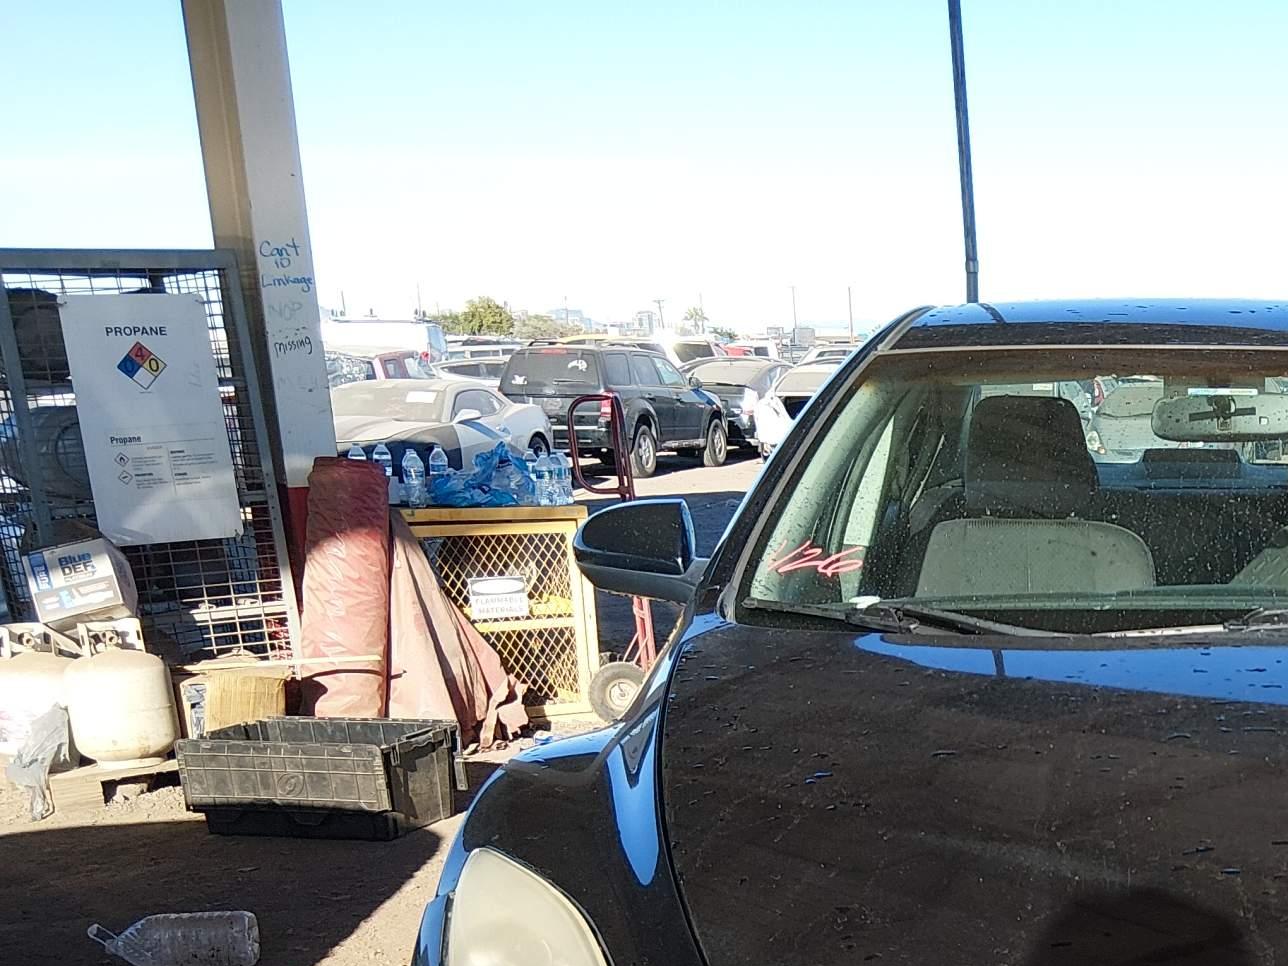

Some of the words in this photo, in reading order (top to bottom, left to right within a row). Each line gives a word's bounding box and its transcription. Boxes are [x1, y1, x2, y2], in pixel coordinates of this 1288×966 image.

[104, 326, 168, 337] PROPANE
[134, 347, 146, 361] 4
[148, 357, 160, 373] 0
[110, 435, 142, 445] Propane
[58, 552, 92, 567] Blue
